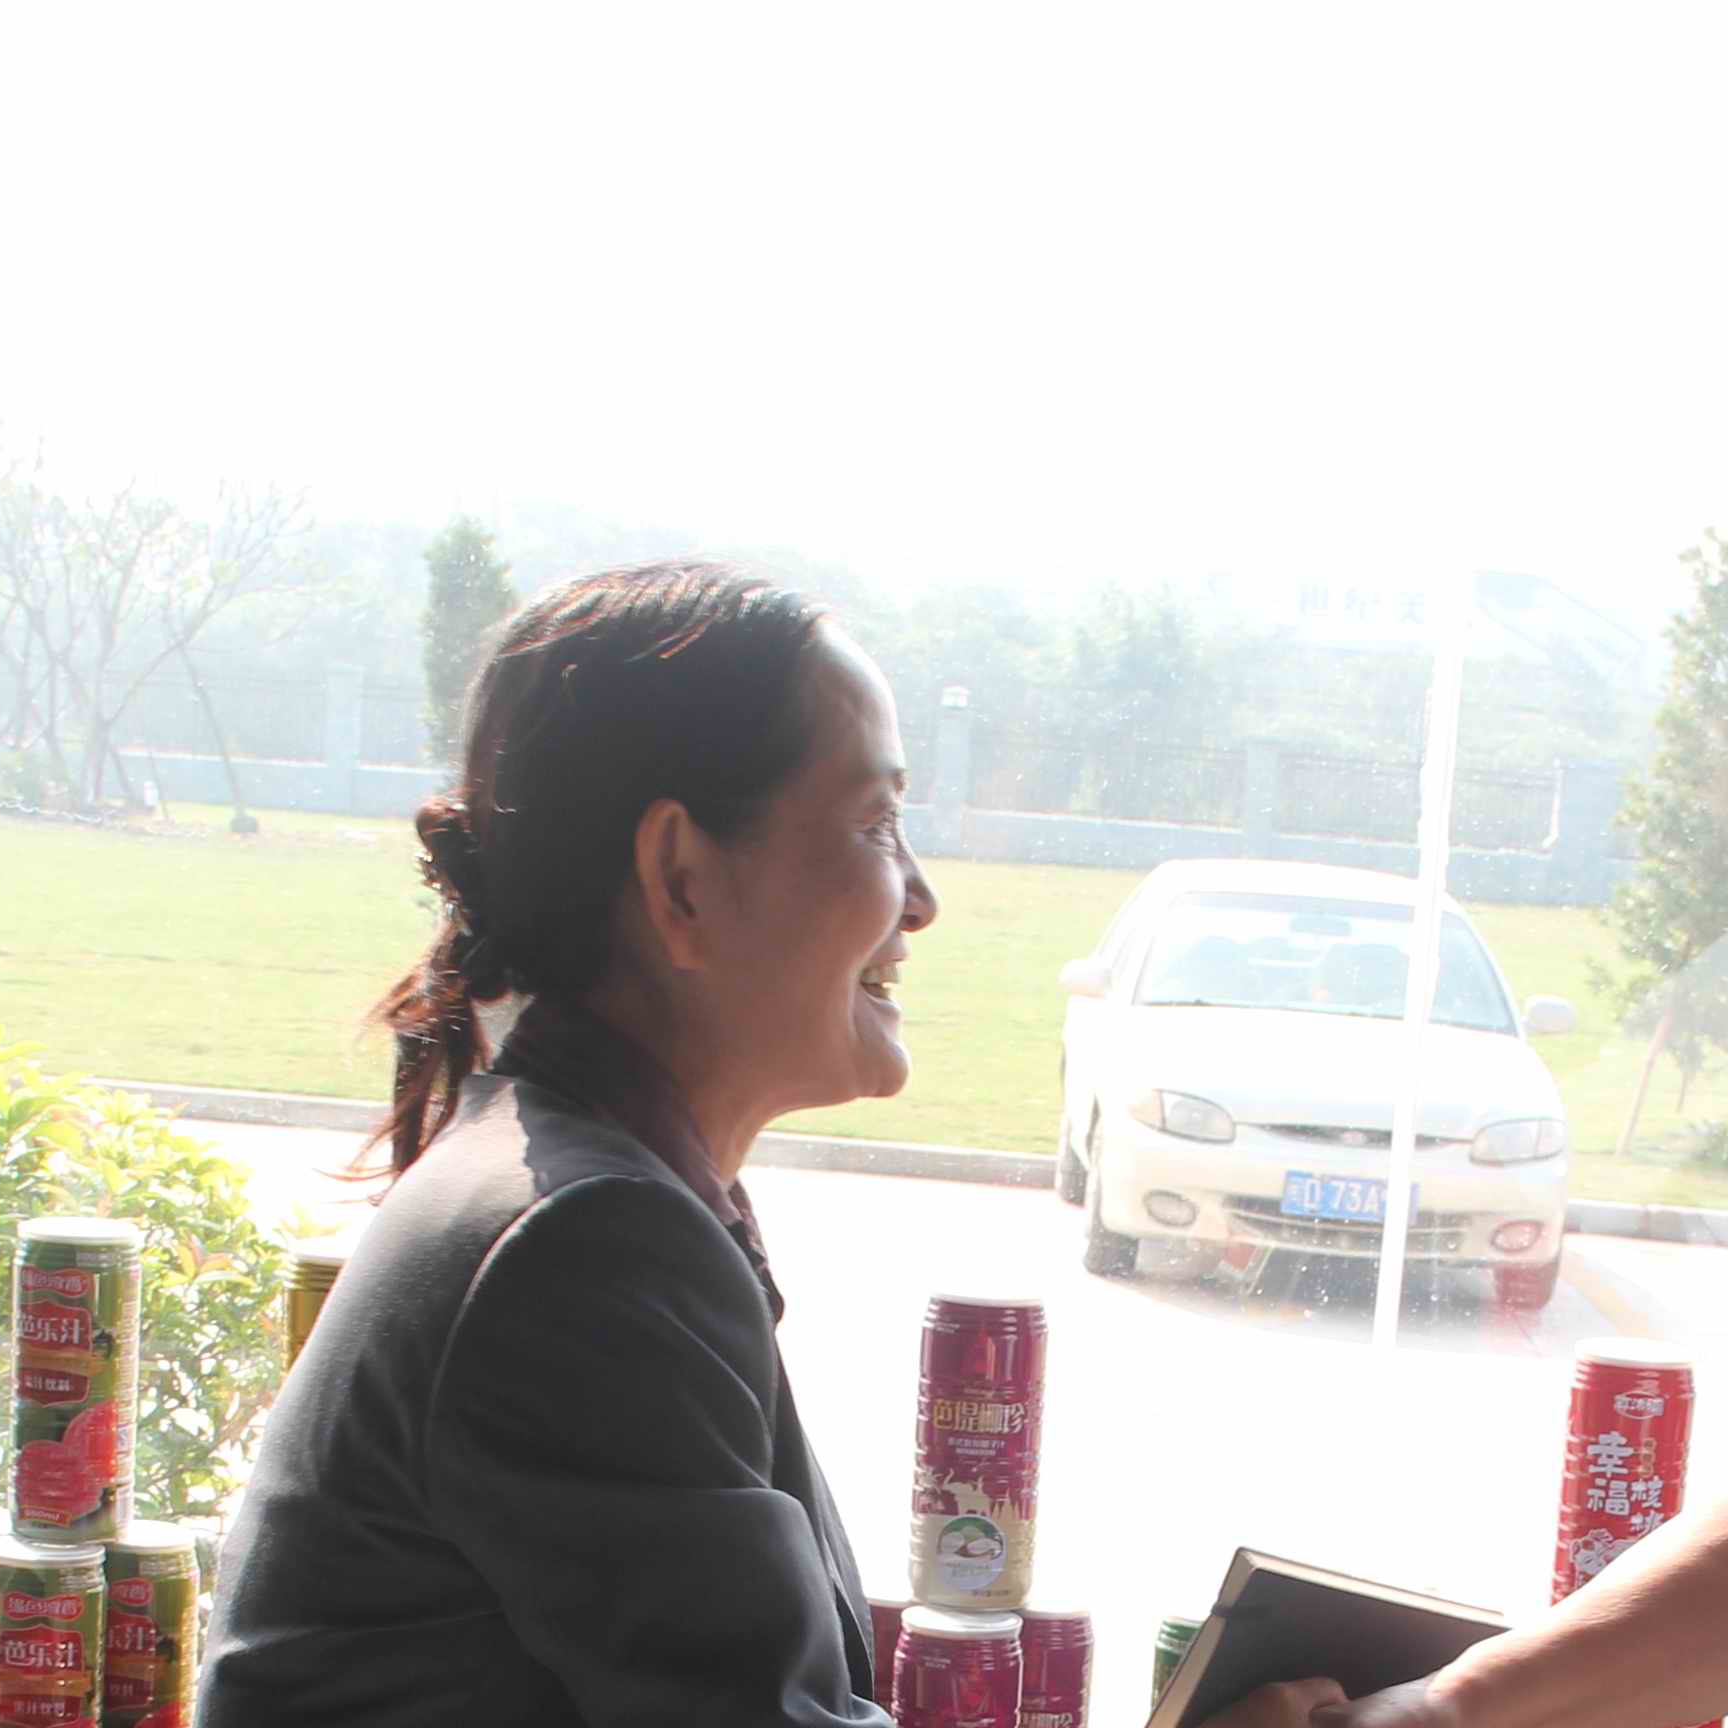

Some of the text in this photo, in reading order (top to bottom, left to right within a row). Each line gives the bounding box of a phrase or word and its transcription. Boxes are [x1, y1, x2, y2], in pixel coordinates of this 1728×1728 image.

[16, 1311, 86, 1345] 芭乐汁
[1587, 1431, 1634, 1516] 幸福
[4, 1640, 78, 1669] 芭乐汁
